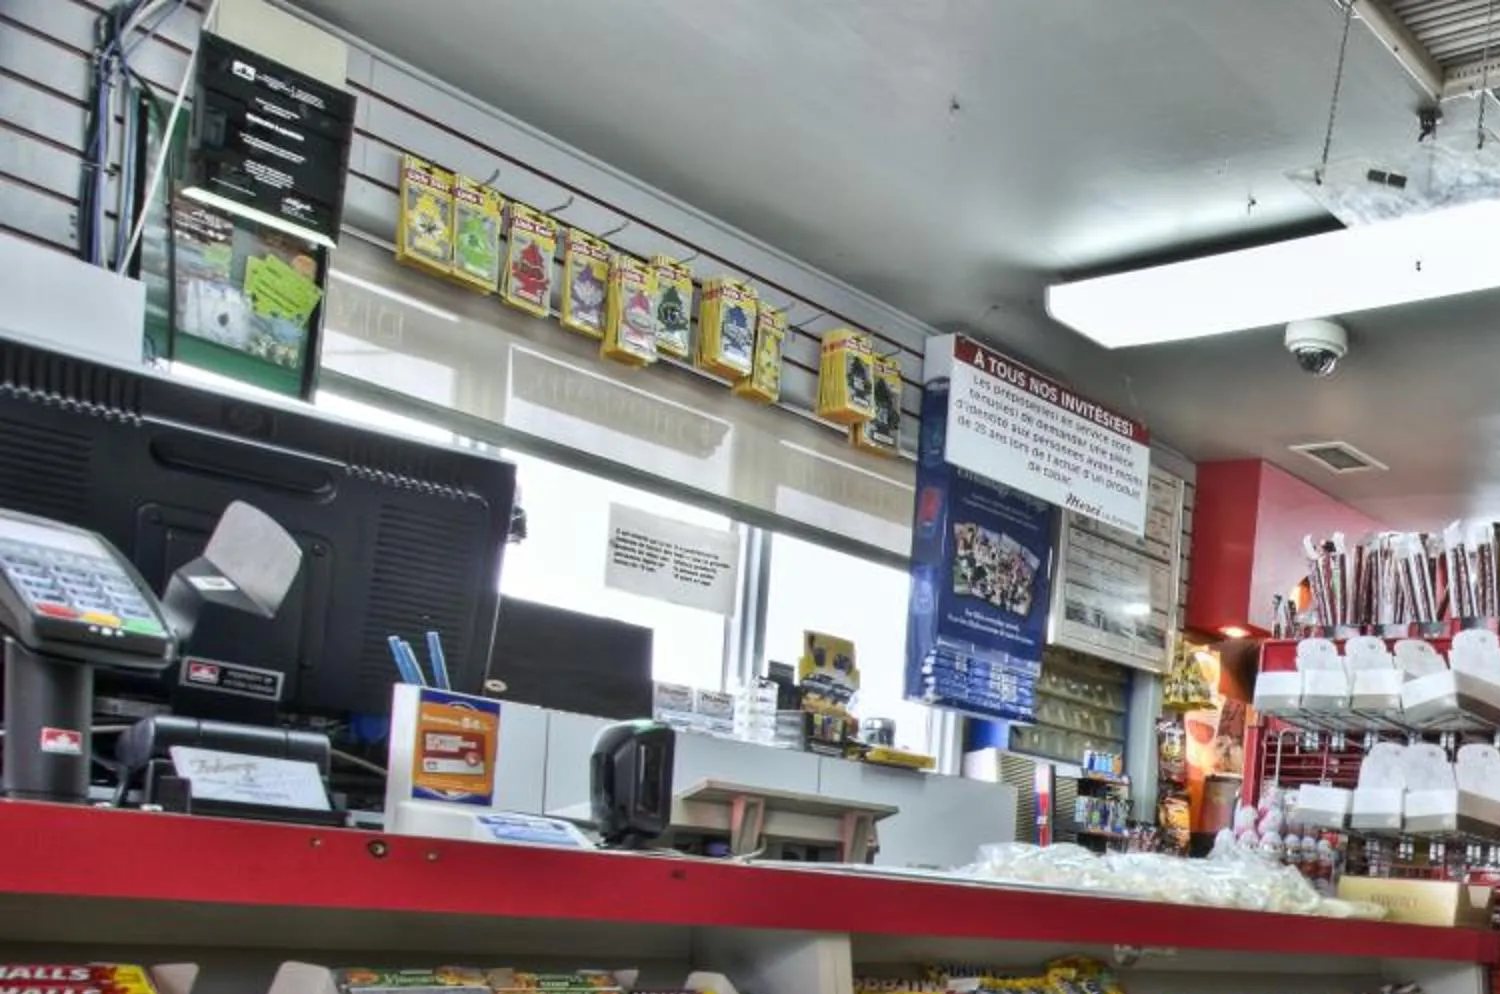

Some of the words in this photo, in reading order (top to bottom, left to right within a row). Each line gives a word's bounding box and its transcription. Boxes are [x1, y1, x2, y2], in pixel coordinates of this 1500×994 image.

[974, 376, 991, 390] Les
[989, 357, 1025, 388] TOUS
[1030, 376, 1058, 402] NOS
